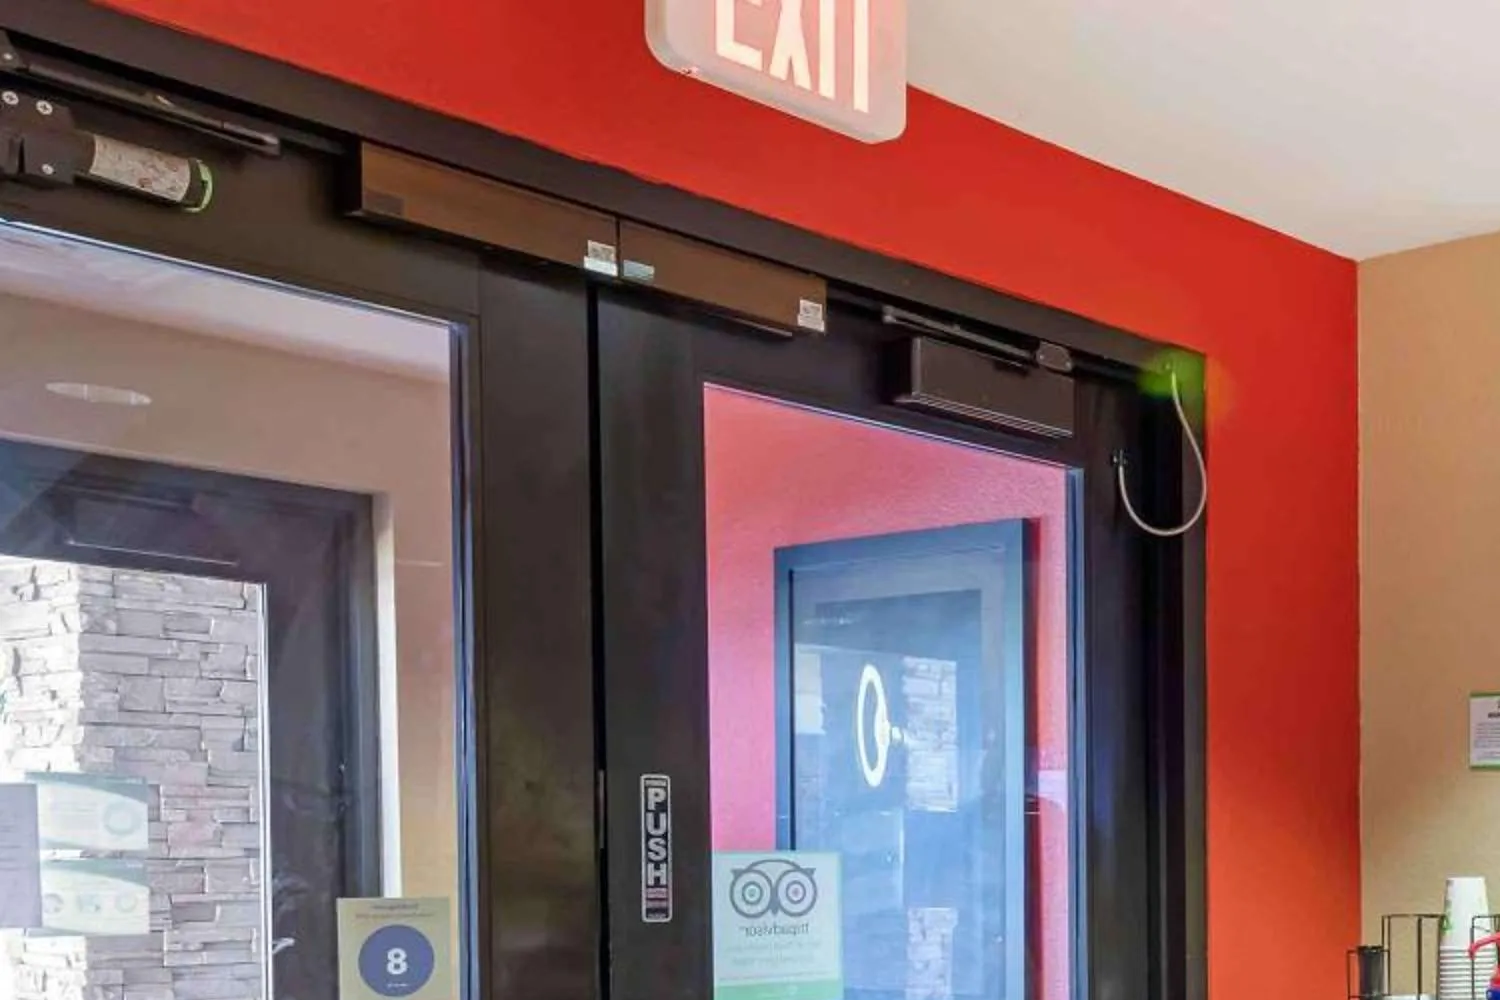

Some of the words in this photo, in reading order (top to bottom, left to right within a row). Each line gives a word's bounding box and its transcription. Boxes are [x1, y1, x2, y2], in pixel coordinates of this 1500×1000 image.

[715, 0, 869, 113] EXIT
[646, 787, 668, 886] PUSH
[386, 947, 408, 975] 8
